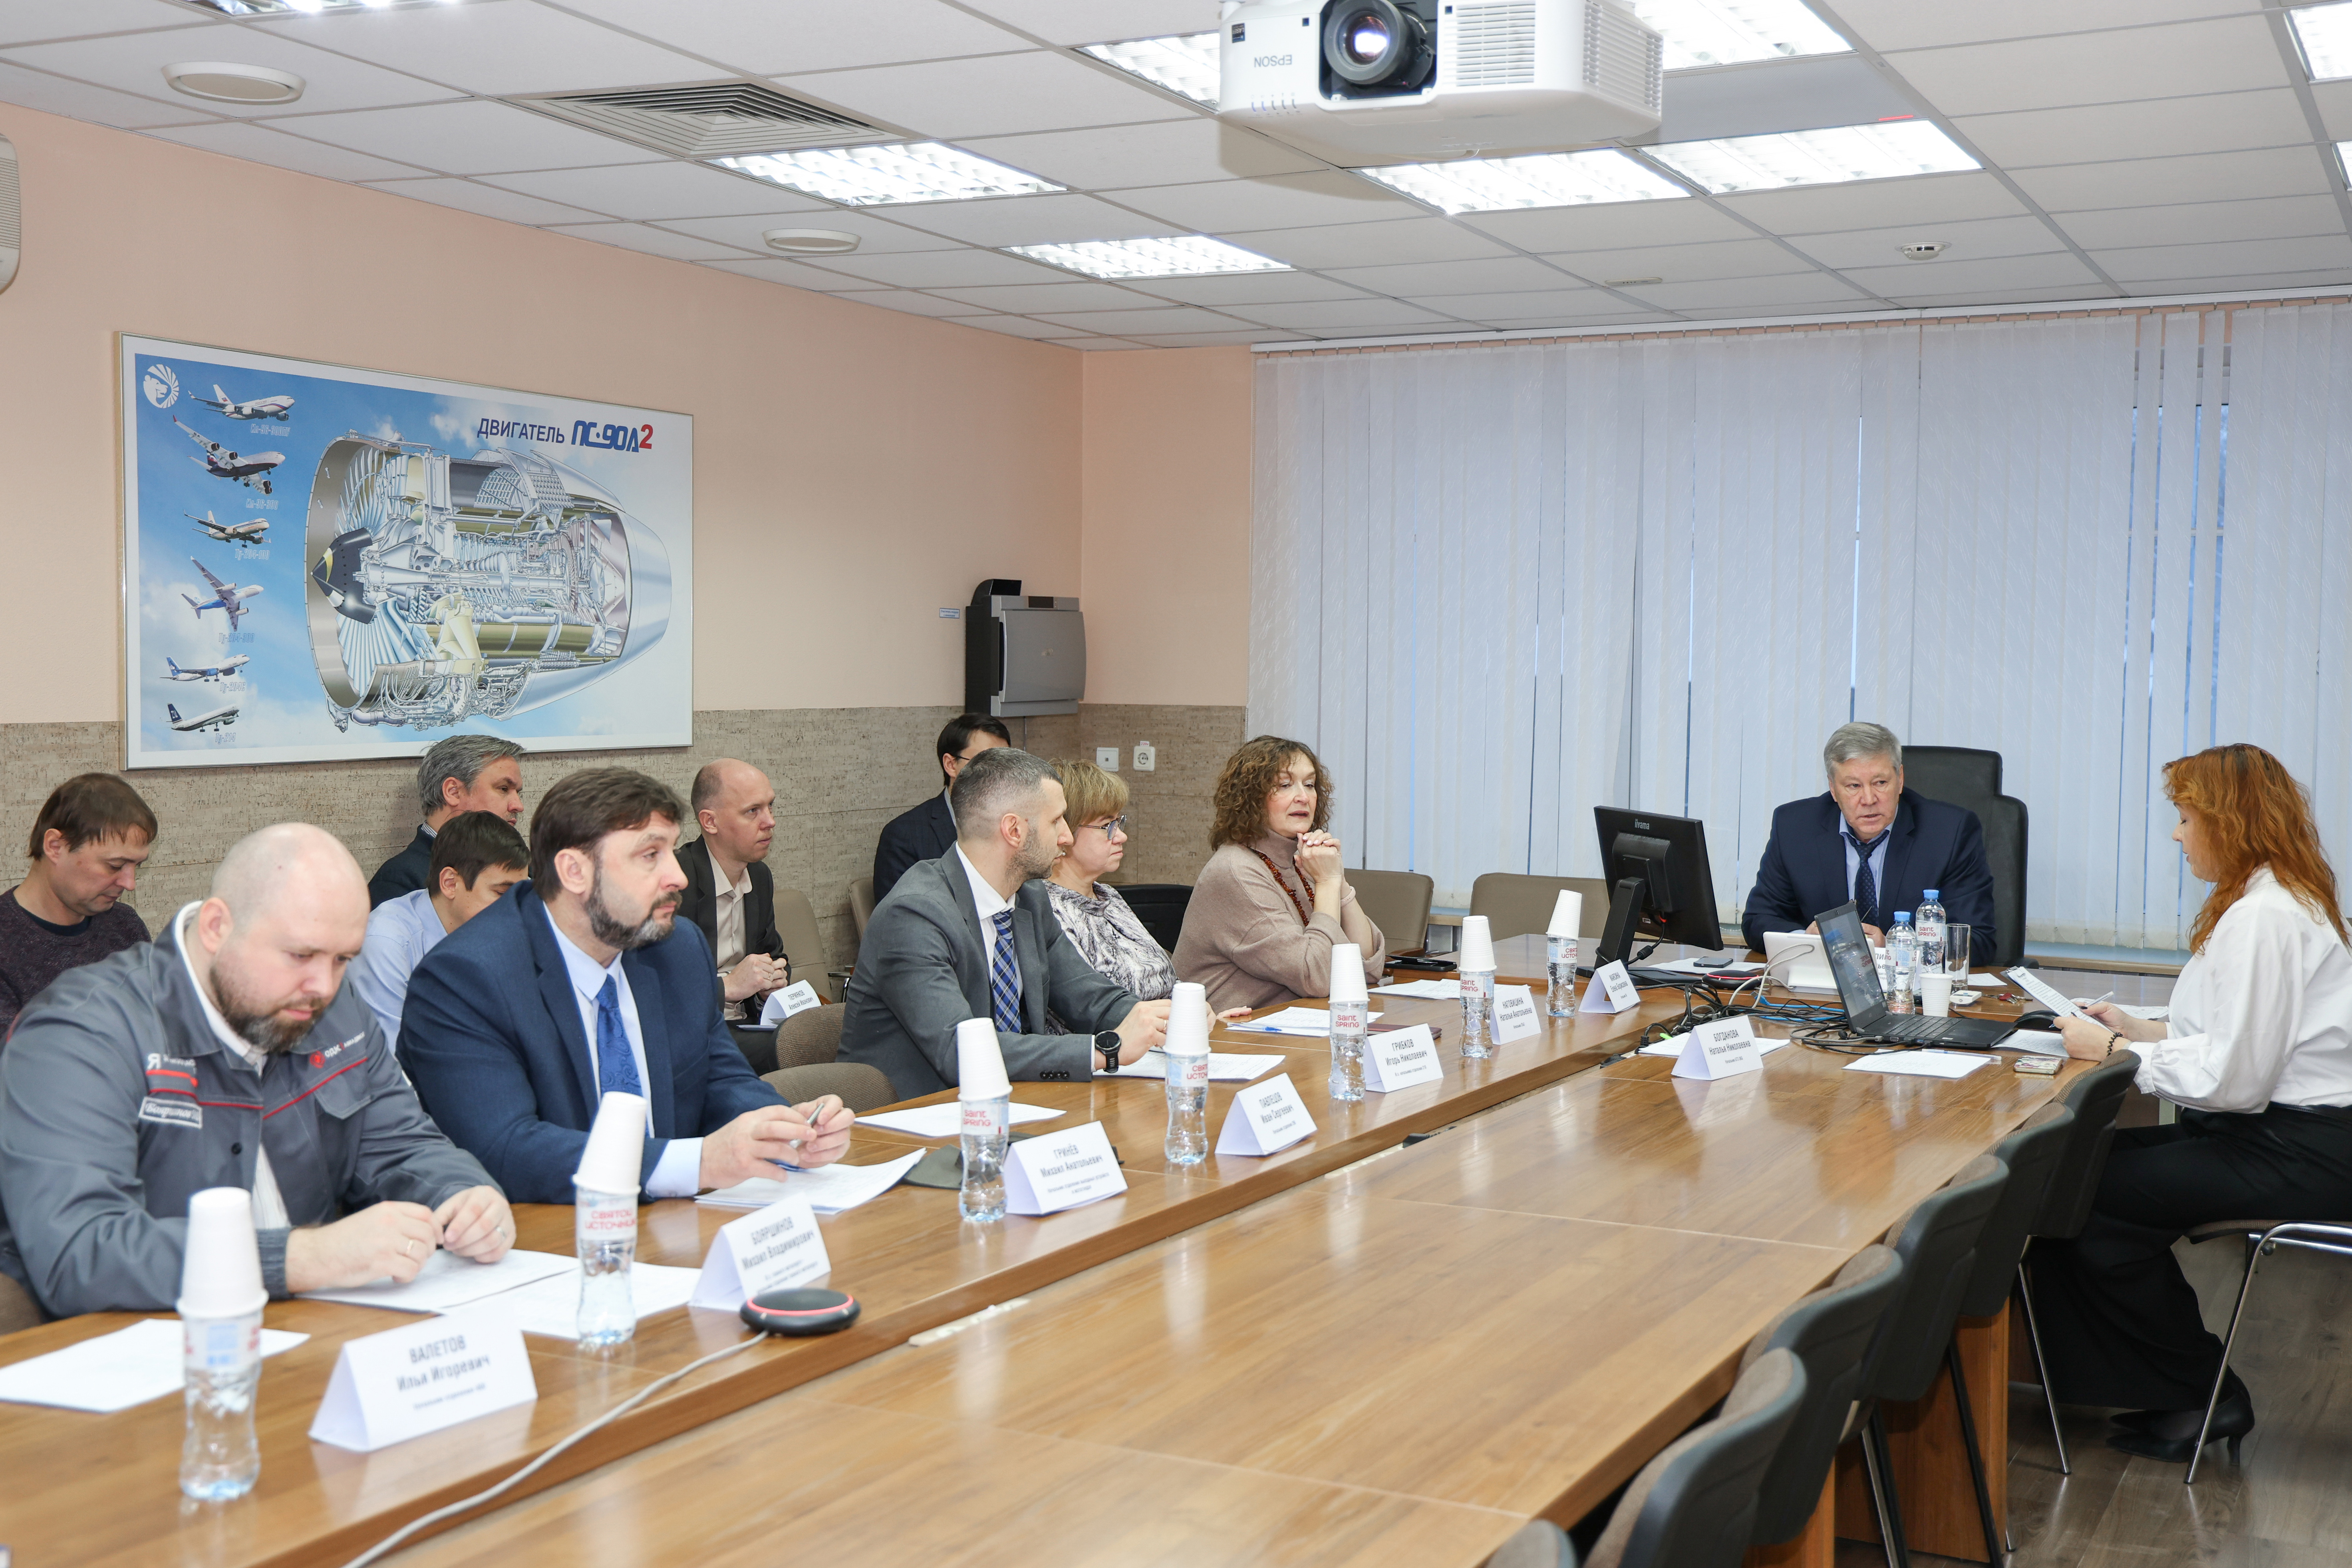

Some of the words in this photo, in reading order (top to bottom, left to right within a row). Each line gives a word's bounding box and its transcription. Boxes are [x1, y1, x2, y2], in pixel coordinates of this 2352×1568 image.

[1254, 54, 1292, 68] EPSON
[477, 418, 564, 443] ДВИГАТЕЛЬ
[215, 733, 236, 744] Ту-214
[1635, 819, 1649, 830] iiyama
[788, 990, 805, 1000] ПЕРМЯКОВ
[1502, 997, 1524, 1009] НАГОВИЦИНА
[1500, 1012, 1513, 1021] Наталья
[1513, 1007, 1532, 1018] Анатольевна
[1713, 1029, 1739, 1042] БОГДАНОВА
[324, 1044, 342, 1058] ОДК
[1392, 1039, 1414, 1051] ГРИБКОВ
[1709, 1046, 1727, 1055] Наталья
[1726, 1040, 1751, 1051] Николаевна
[1385, 1057, 1400, 1066] Игорь
[1400, 1050, 1427, 1063] Николаевич
[1260, 1113, 1273, 1124] Иван
[1271, 1104, 1294, 1119] Сергеевич
[1053, 1143, 1079, 1159] ГРИНЁВ
[1040, 1165, 1065, 1177] Михаил
[1065, 1155, 1103, 1171] Анатольевич
[742, 1251, 767, 1270] Михаил
[767, 1229, 815, 1258] Владимирович
[409, 1335, 467, 1363] ВАЛЕТОВ
[396, 1374, 428, 1392] Илья
[431, 1355, 491, 1380] Игоревич
